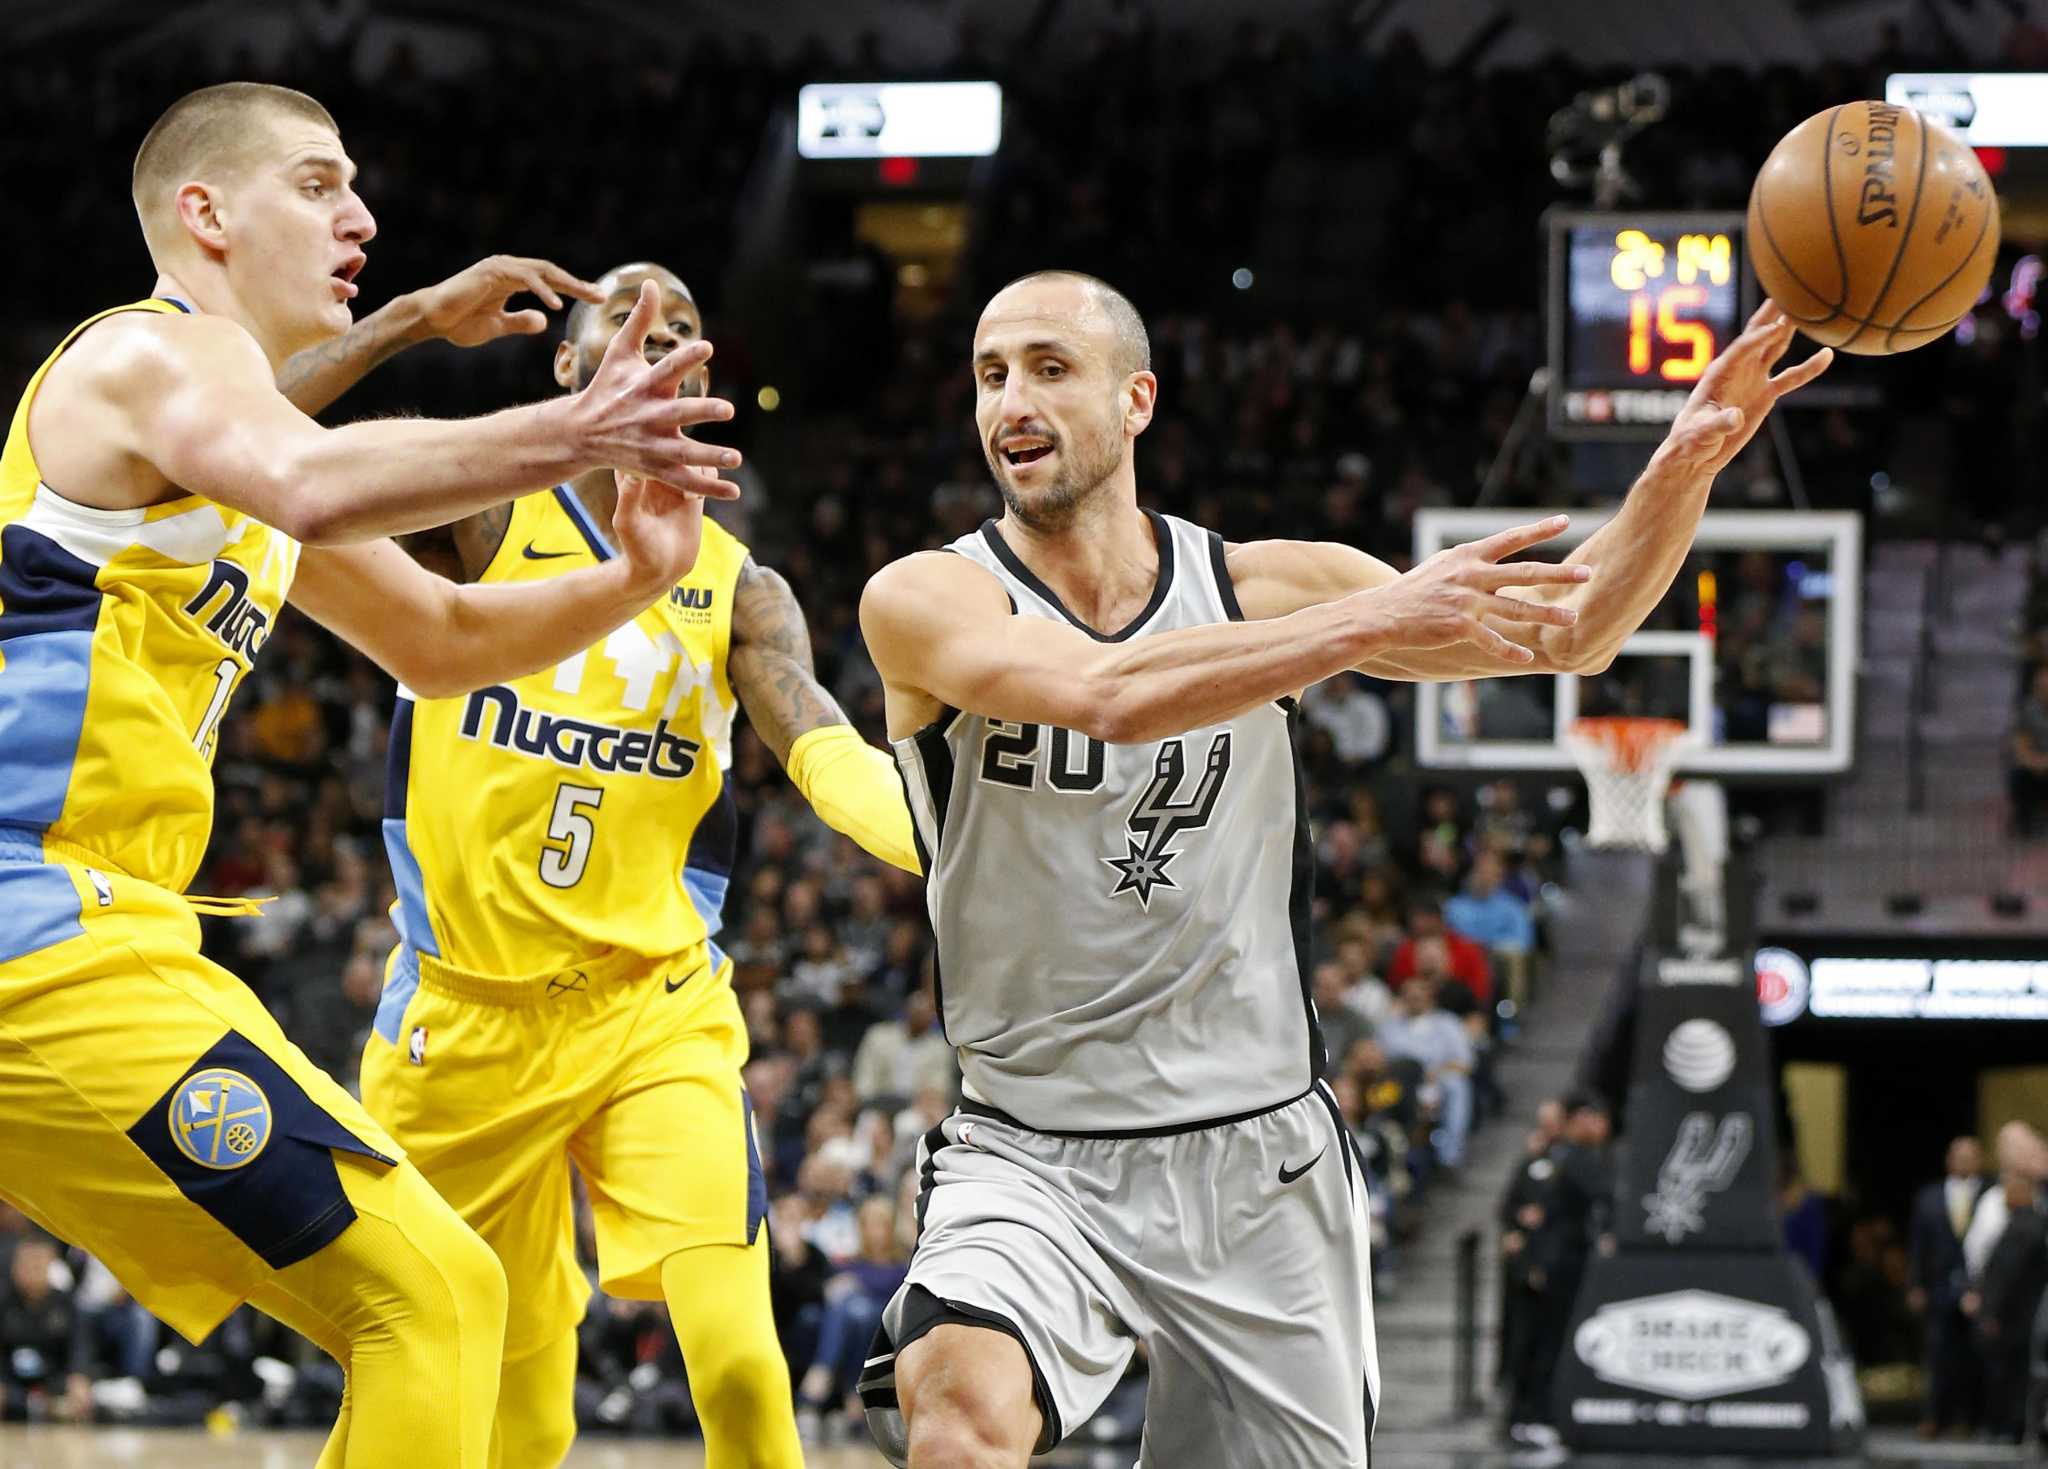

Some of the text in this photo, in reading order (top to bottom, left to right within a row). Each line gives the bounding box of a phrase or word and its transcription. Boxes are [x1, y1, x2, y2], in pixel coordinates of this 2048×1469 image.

[1629, 287, 1715, 381] 15
[671, 586, 713, 609] WU
[460, 683, 701, 780] Nuggets
[979, 717, 1108, 794] 20
[538, 782, 605, 889] 5
